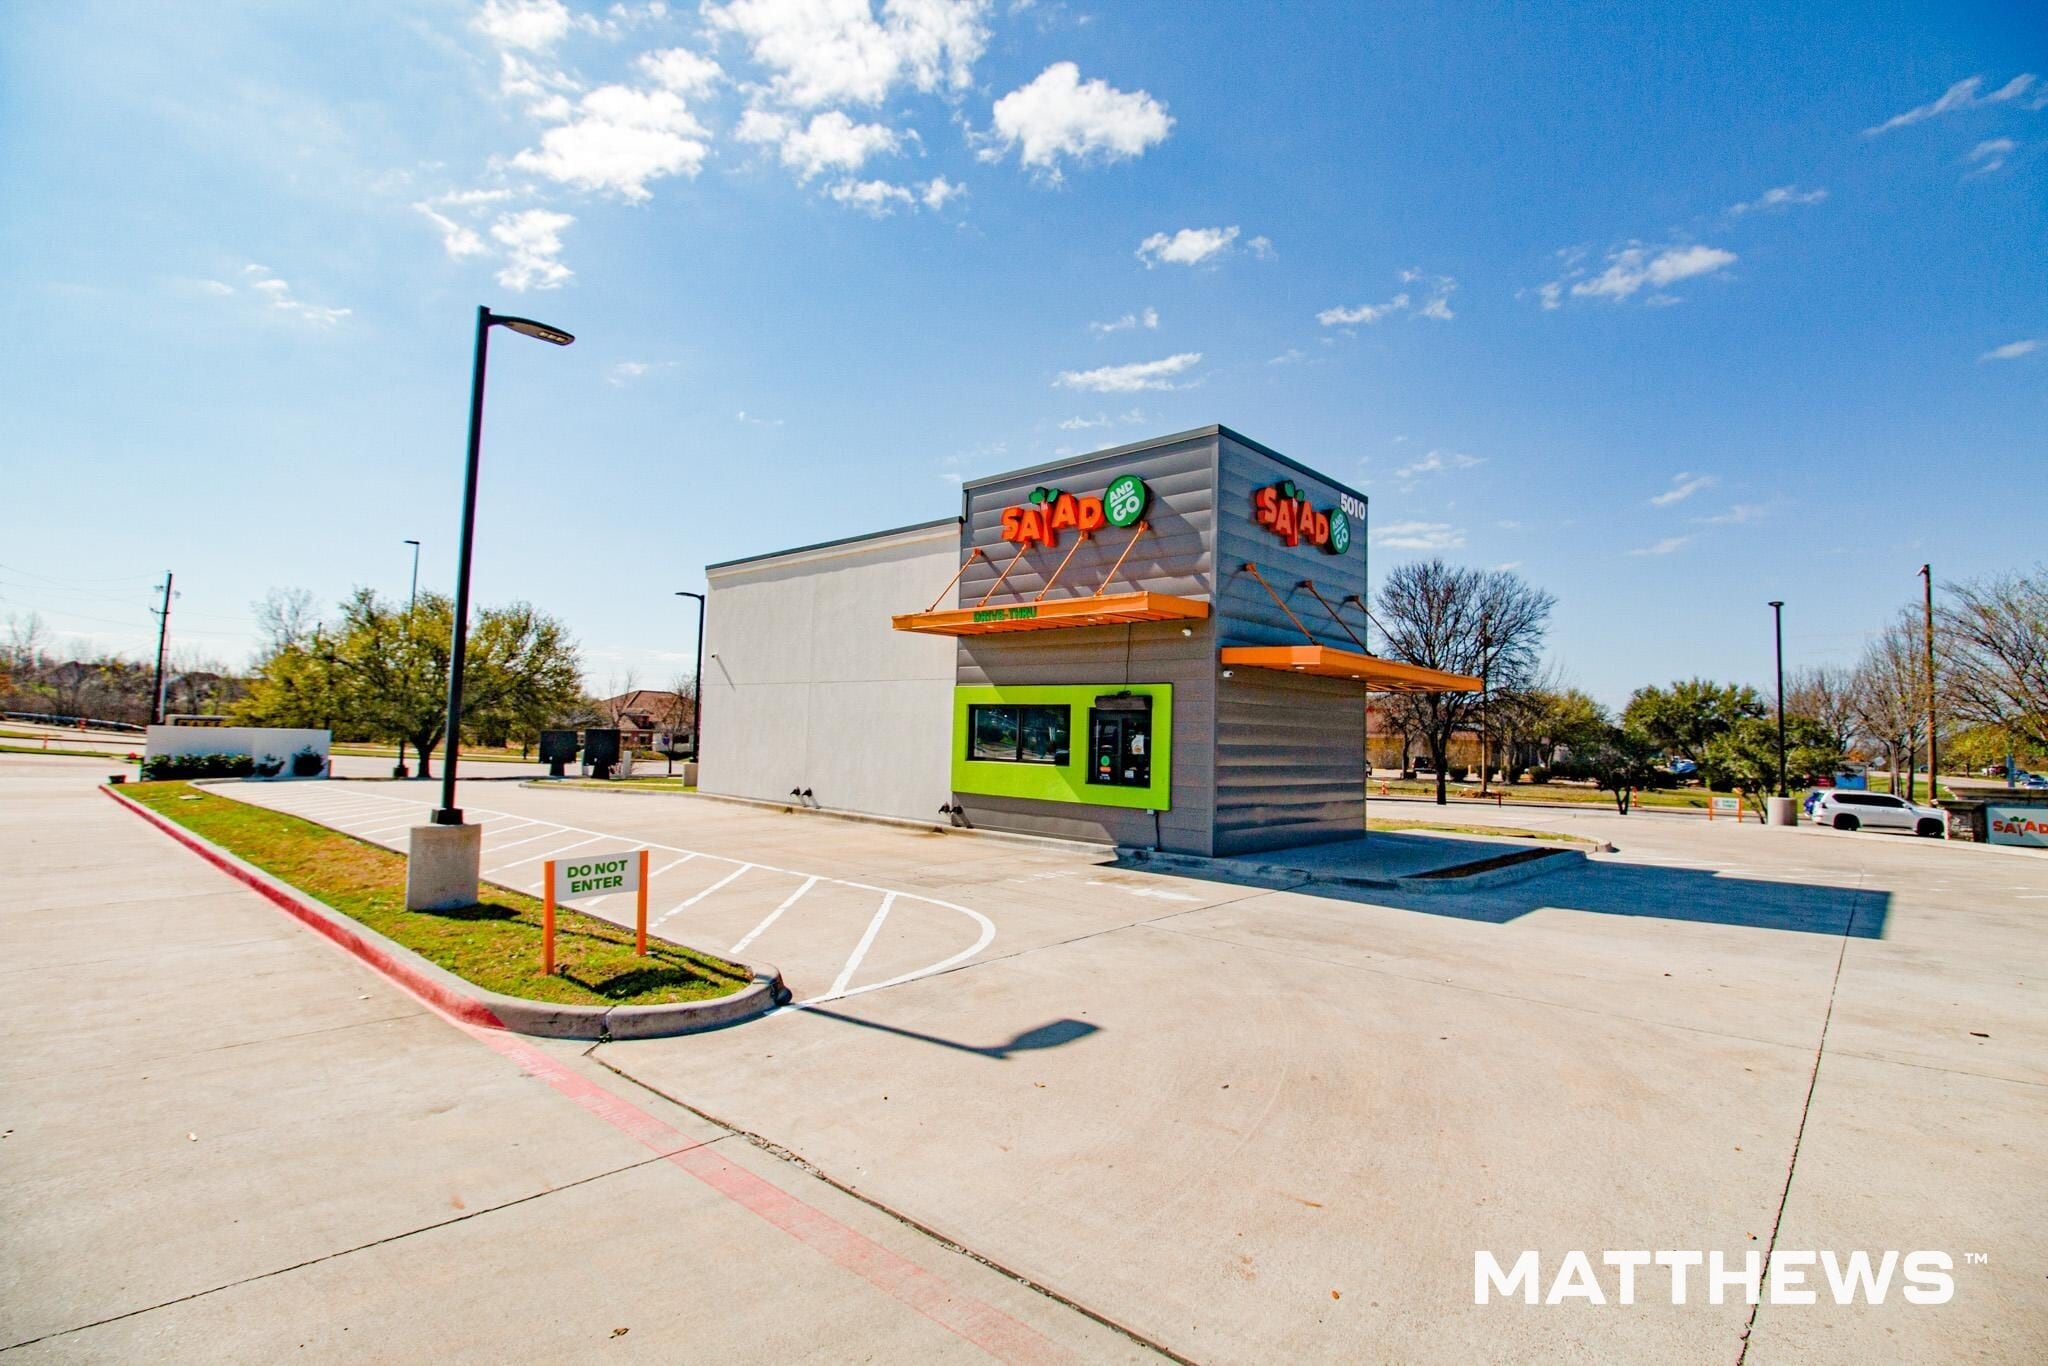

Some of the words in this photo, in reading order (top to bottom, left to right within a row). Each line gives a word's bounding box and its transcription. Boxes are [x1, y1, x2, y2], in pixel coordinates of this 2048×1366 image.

[1109, 480, 1134, 504] AND
[1113, 496, 1140, 521] GO
[1256, 486, 1329, 547] SALAD
[1341, 493, 1366, 520] 5010
[1002, 492, 1105, 547] SALAD
[1336, 528, 1349, 549] GO
[973, 606, 1037, 622] DRIVE-THRU
[567, 865, 592, 878] DO
[595, 860, 628, 874] NOT
[571, 875, 623, 893] ENTER
